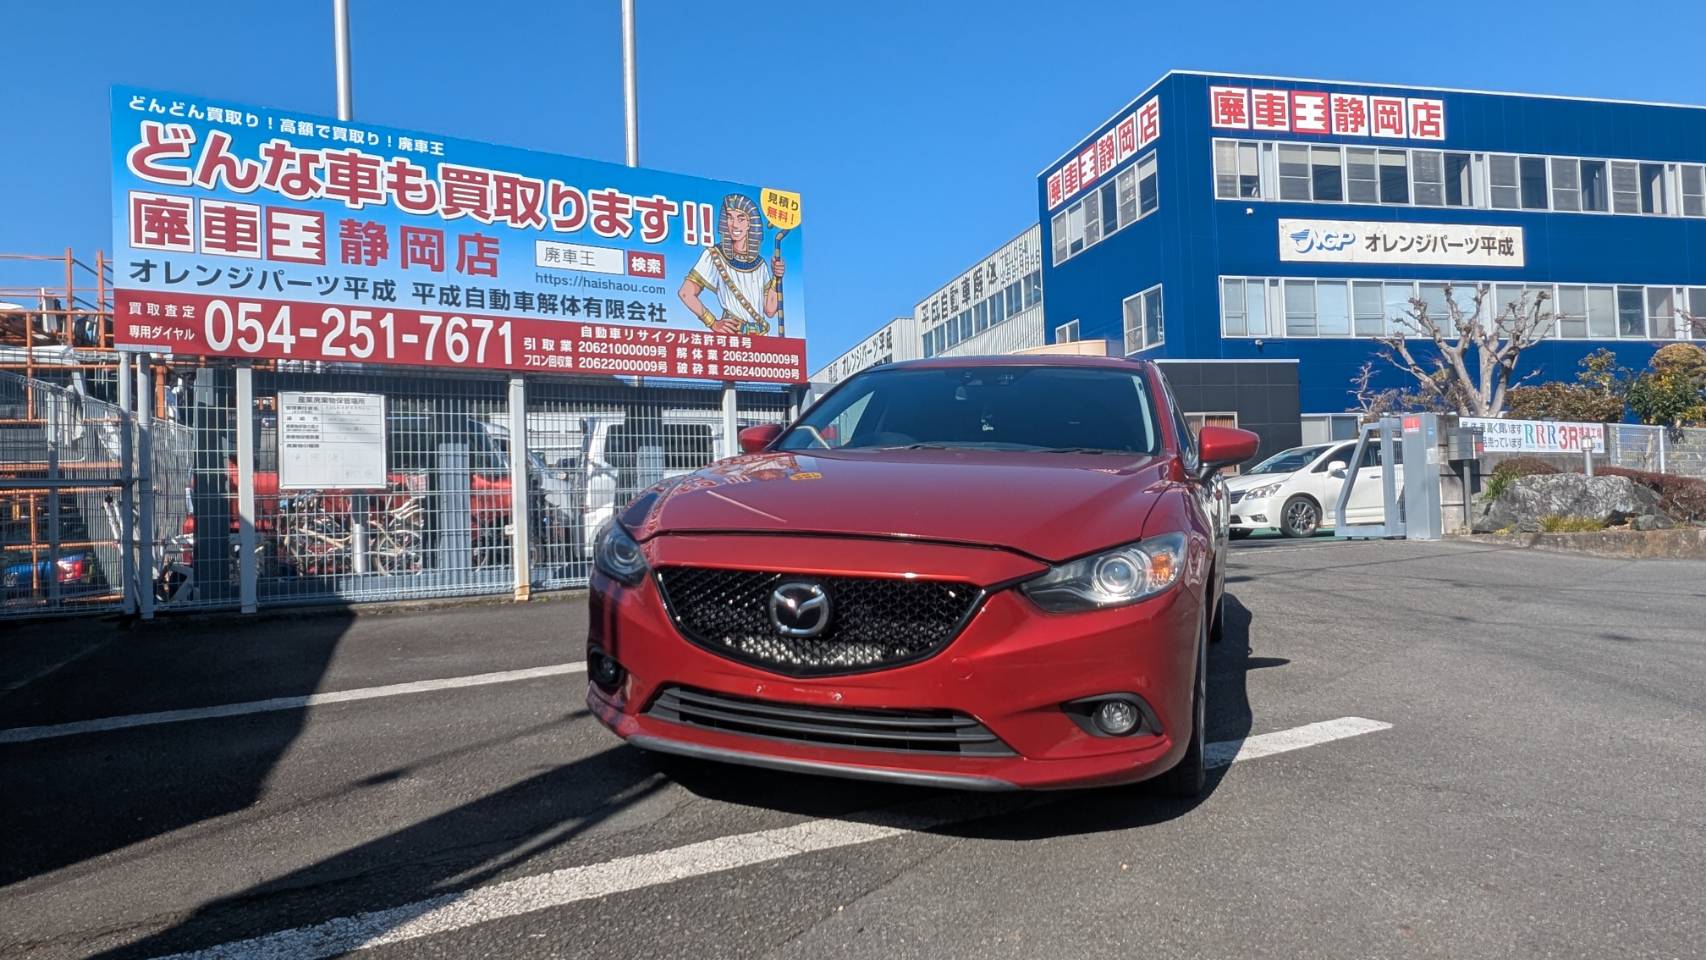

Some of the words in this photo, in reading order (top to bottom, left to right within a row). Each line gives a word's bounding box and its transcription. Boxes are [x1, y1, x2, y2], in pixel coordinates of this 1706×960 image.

[1213, 91, 1441, 138] 廃車王静岡店
[1048, 100, 1158, 207] 廃車王静岡店
[768, 192, 798, 211] 見積り
[1365, 234, 1515, 256] オレンジパーツ平成
[544, 246, 596, 268] 廃車王
[631, 254, 662, 274] 検索
[129, 259, 397, 303] オレンジパーツ平成
[412, 281, 668, 323] 平成自動車解体有限会社
[535, 272, 666, 295] https://haishaou.com
[128, 302, 195, 319] 買取査定
[128, 324, 195, 341] 専用ダイヤル
[204, 299, 513, 365] 054-251-7671
[581, 326, 752, 349] 自動車リサイクル法許可番号
[523, 337, 573, 353] 引取業
[578, 341, 667, 358] 20621000009号
[676, 347, 718, 361] 解体業
[723, 350, 800, 366] 20623000009号
[524, 355, 573, 369] フロン回収業
[579, 357, 668, 374] 20622000009号
[677, 362, 719, 376] 破砕業
[723, 365, 800, 380] 20624000009号
